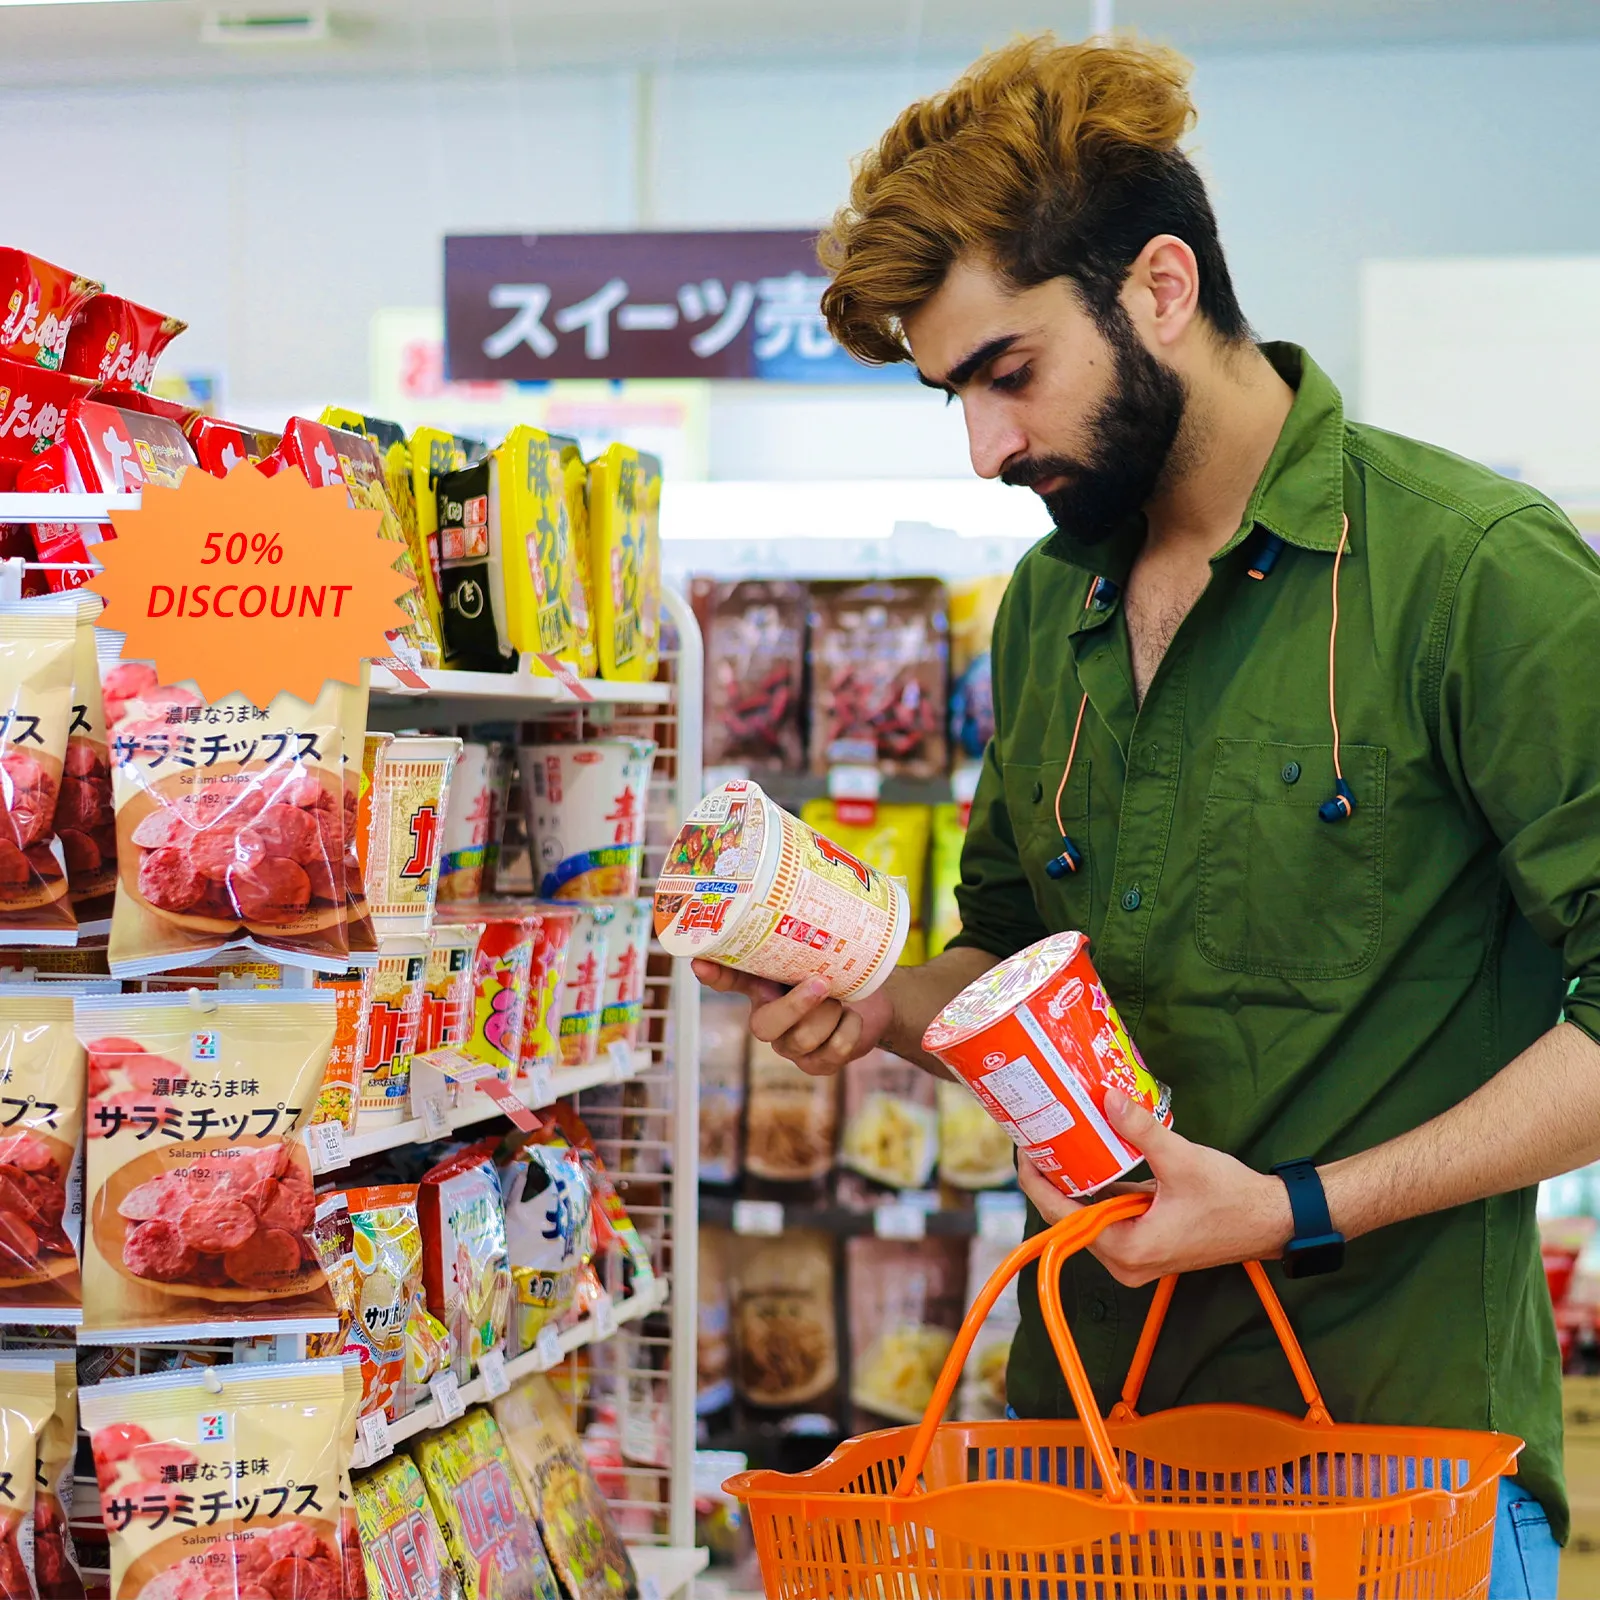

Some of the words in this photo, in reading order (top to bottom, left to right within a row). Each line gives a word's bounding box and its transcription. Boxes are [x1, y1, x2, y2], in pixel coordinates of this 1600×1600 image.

[482, 272, 836, 361] スイーツ売
[164, 706, 270, 725] 濃厚なうま味
[111, 726, 322, 768] サラミチップス
[180, 775, 218, 785] Salami
[220, 774, 250, 786] Chips
[152, 1077, 260, 1098] 濃厚なうま味
[94, 1102, 303, 1142] サラミチップス
[168, 1148, 206, 1159] Salami
[209, 1148, 241, 1160] Chips
[159, 1457, 271, 1485] 濃厚なうま味
[106, 1479, 323, 1532] サラミチップス
[182, 1533, 221, 1546] Salami
[224, 1530, 255, 1543] Chips
